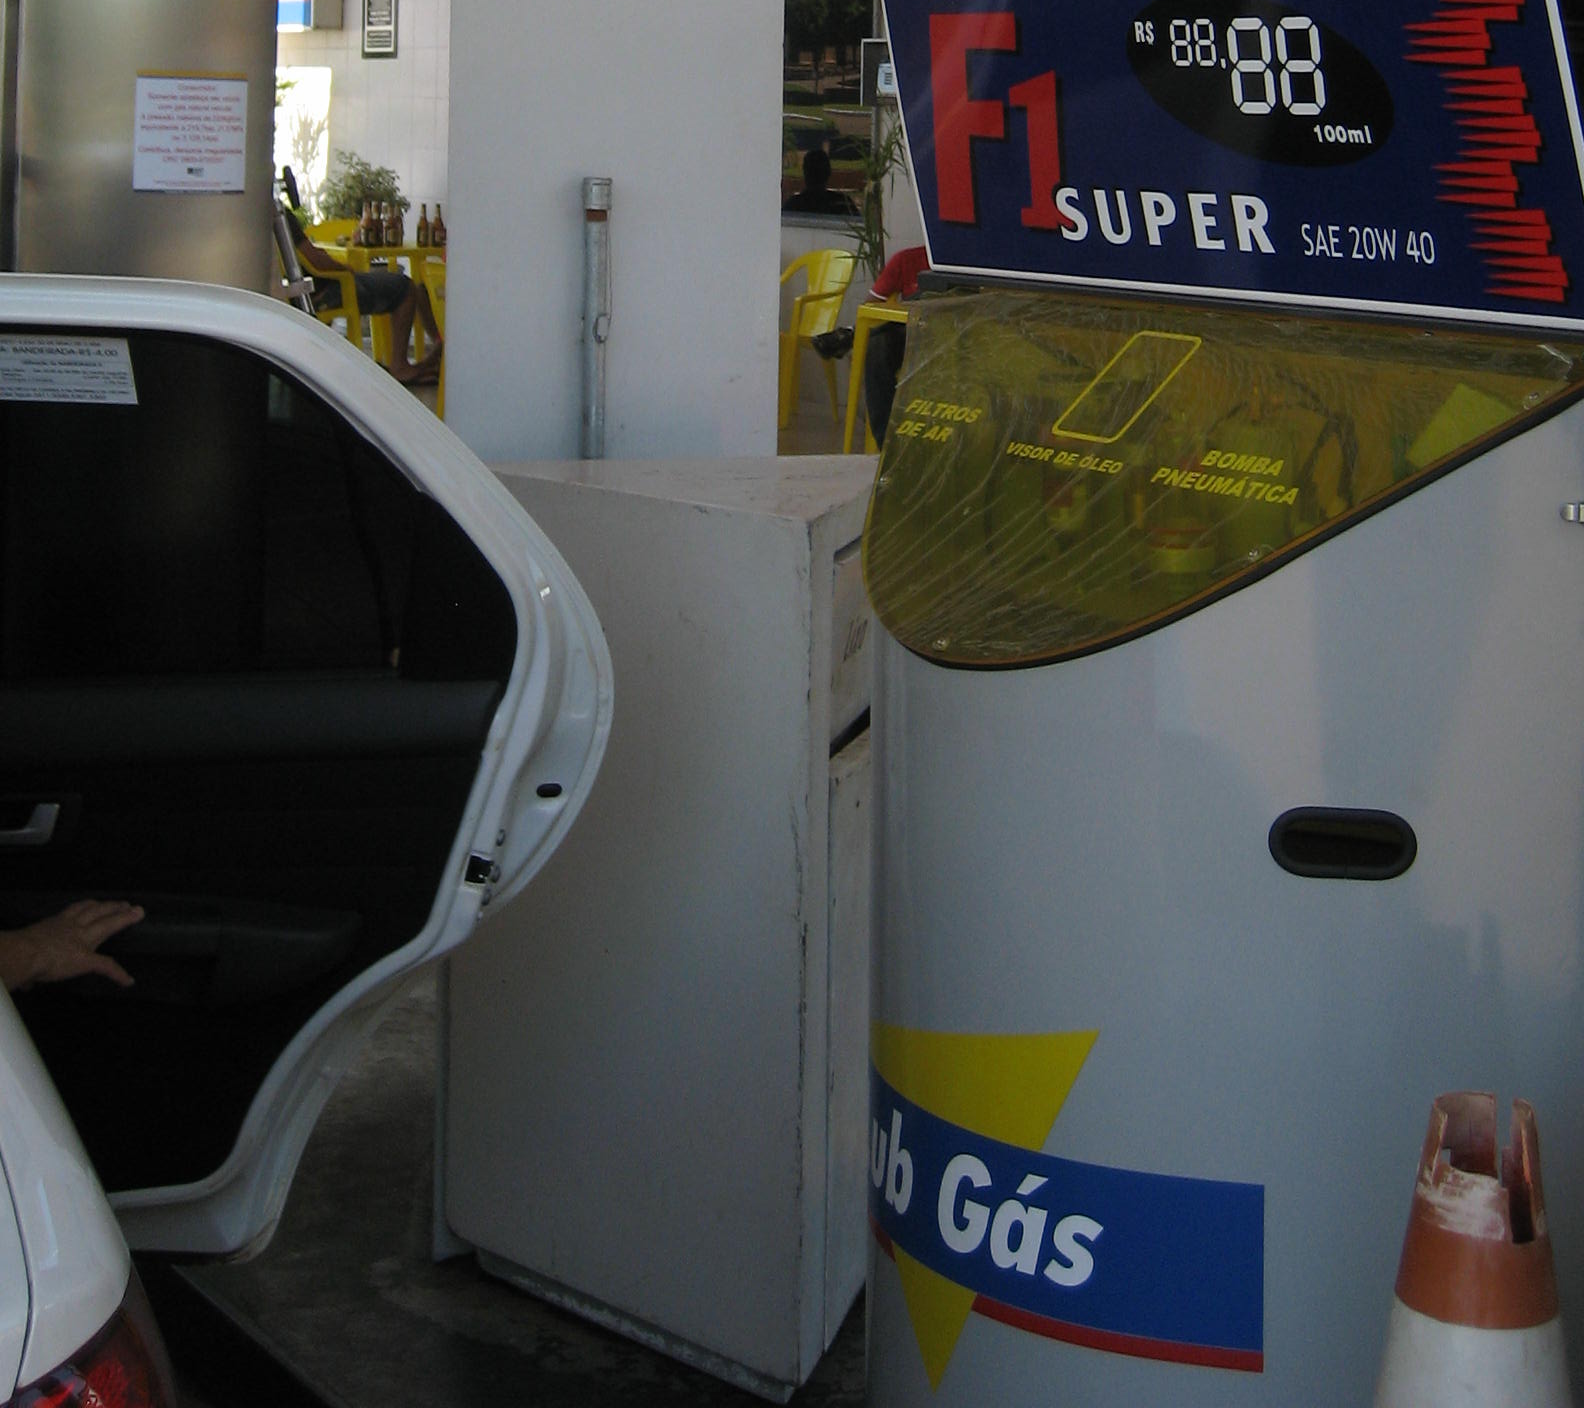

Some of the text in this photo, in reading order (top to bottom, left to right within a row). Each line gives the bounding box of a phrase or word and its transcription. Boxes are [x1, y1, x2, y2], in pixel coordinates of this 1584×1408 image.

[1134, 21, 1155, 45] R$
[929, 12, 1076, 231] F1
[1313, 124, 1372, 144] 100ml
[1055, 187, 1276, 254] SUPER
[1300, 223, 1436, 265] SAE 20W 40
[904, 399, 983, 424] FILTROS
[896, 420, 952, 443] DE AR
[1005, 442, 1124, 475] VISOR DE ÓLEO
[1200, 450, 1285, 476] BOMBA
[1150, 466, 1300, 506] PNEUMÁTICA
[938, 1153, 1104, 1287] Gás
